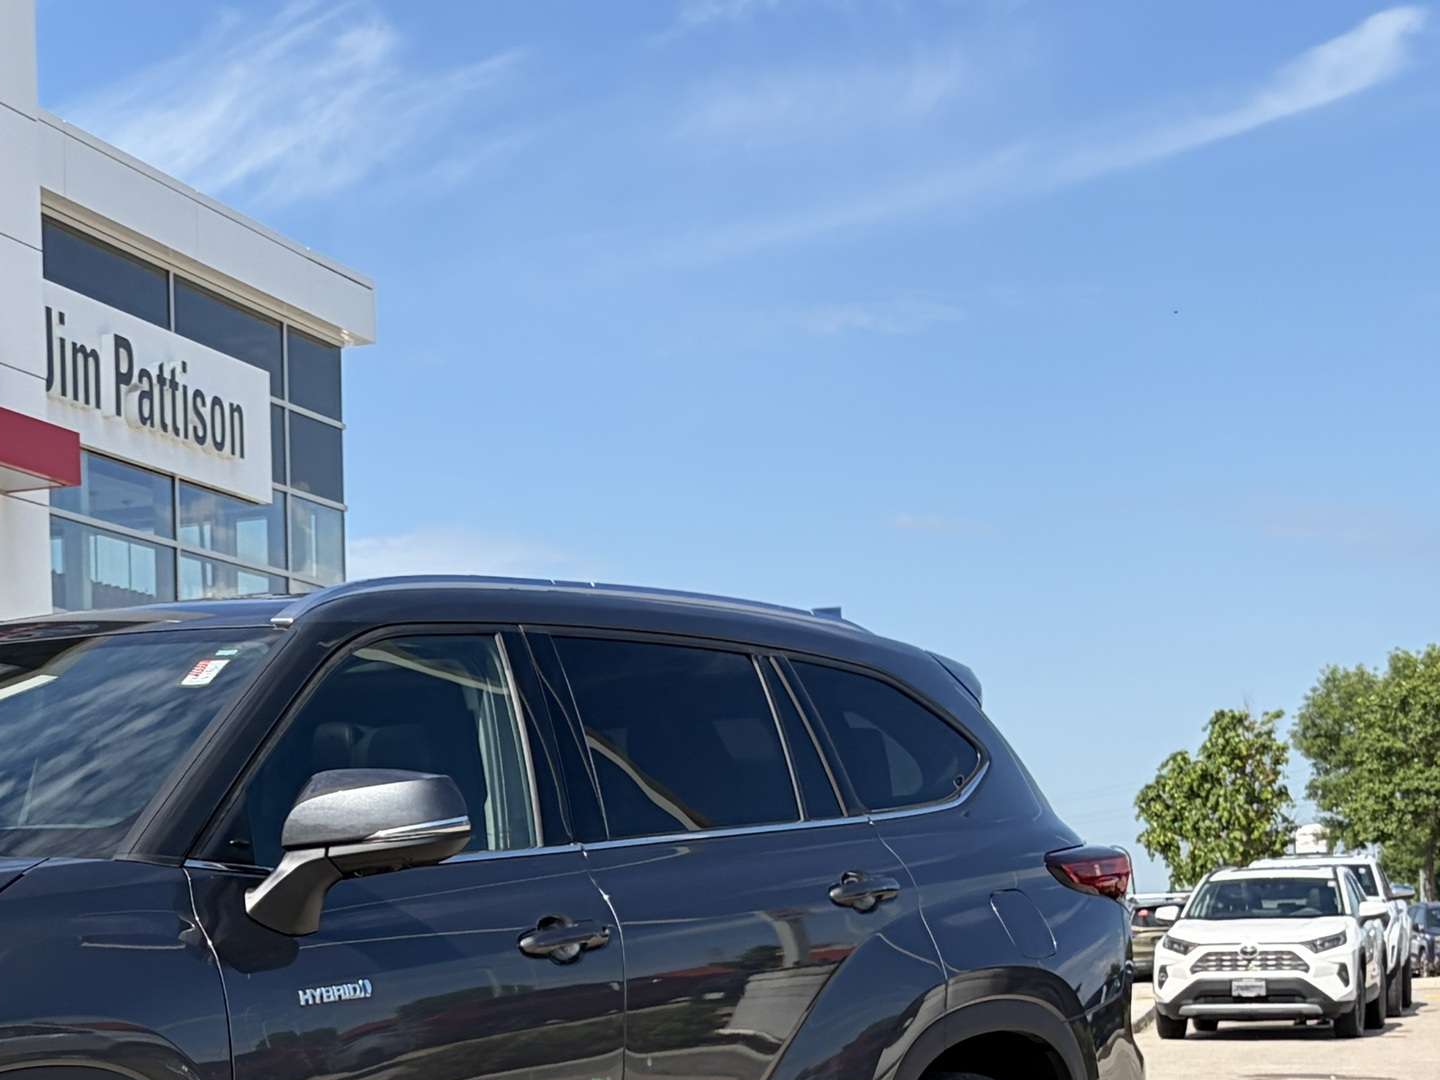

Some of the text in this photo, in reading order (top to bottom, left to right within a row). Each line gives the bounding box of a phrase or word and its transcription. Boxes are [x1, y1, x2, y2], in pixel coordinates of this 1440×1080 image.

[45, 305, 245, 459] Jim Pattison
[298, 982, 363, 1006] HYBRID
